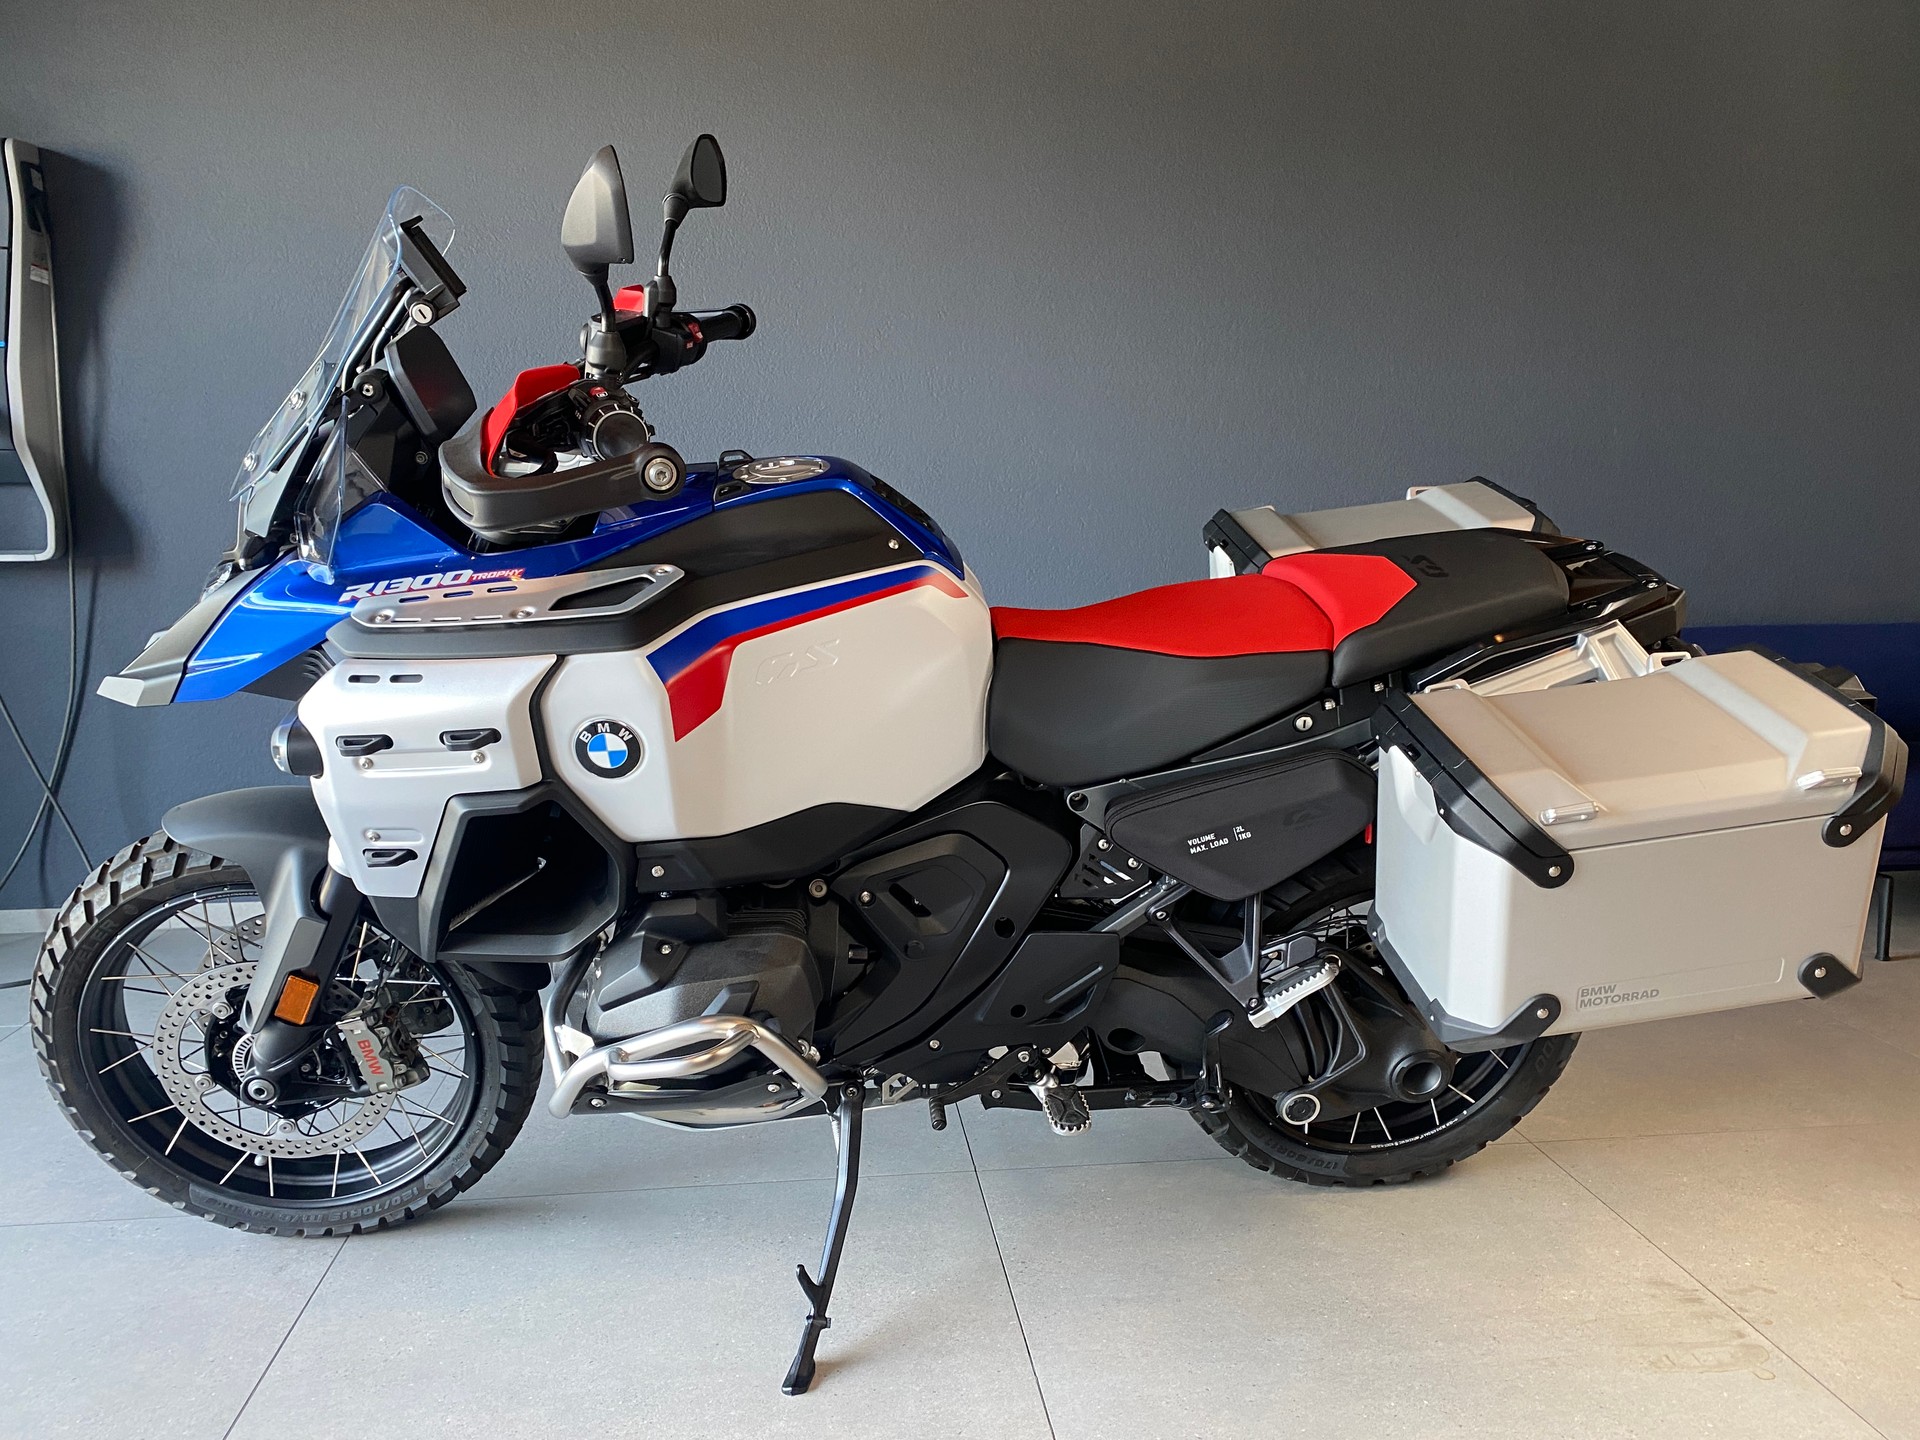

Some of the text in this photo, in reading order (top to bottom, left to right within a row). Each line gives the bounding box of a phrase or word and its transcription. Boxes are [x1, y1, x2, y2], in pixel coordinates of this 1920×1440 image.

[338, 568, 524, 602] R1300 TROPHY
[579, 722, 633, 743] BMW
[1187, 825, 1245, 846] VOLUME 2L
[1190, 831, 1252, 854] MAX. LOAD 1KG
[1579, 989, 1659, 1009] MOTORRAD
[1580, 984, 1617, 998] BMW
[357, 1039, 385, 1075] BMW
